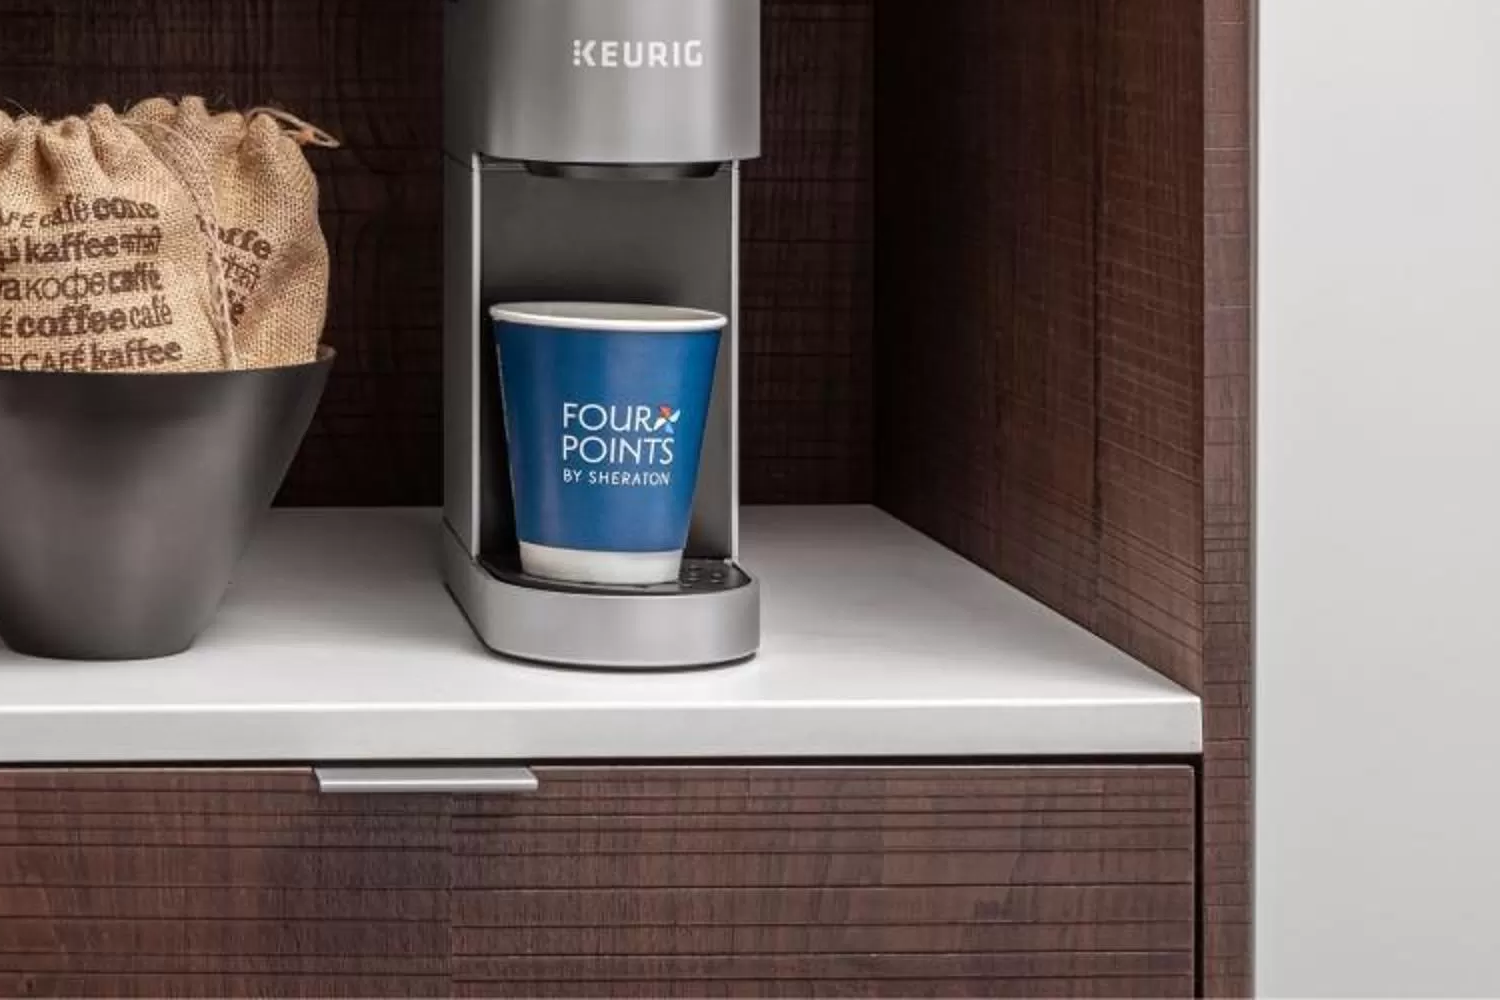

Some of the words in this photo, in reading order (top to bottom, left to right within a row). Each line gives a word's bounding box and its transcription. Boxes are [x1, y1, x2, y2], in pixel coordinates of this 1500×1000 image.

[573, 39, 703, 68] KEURIG
[24, 230, 118, 263] kaffee
[16, 303, 127, 338] coffee
[130, 294, 173, 329] café
[91, 337, 183, 370] kaffee
[563, 402, 653, 432] FOUR
[563, 434, 675, 465] POINTS
[563, 468, 582, 483] BY
[589, 470, 671, 486] SHERATON
